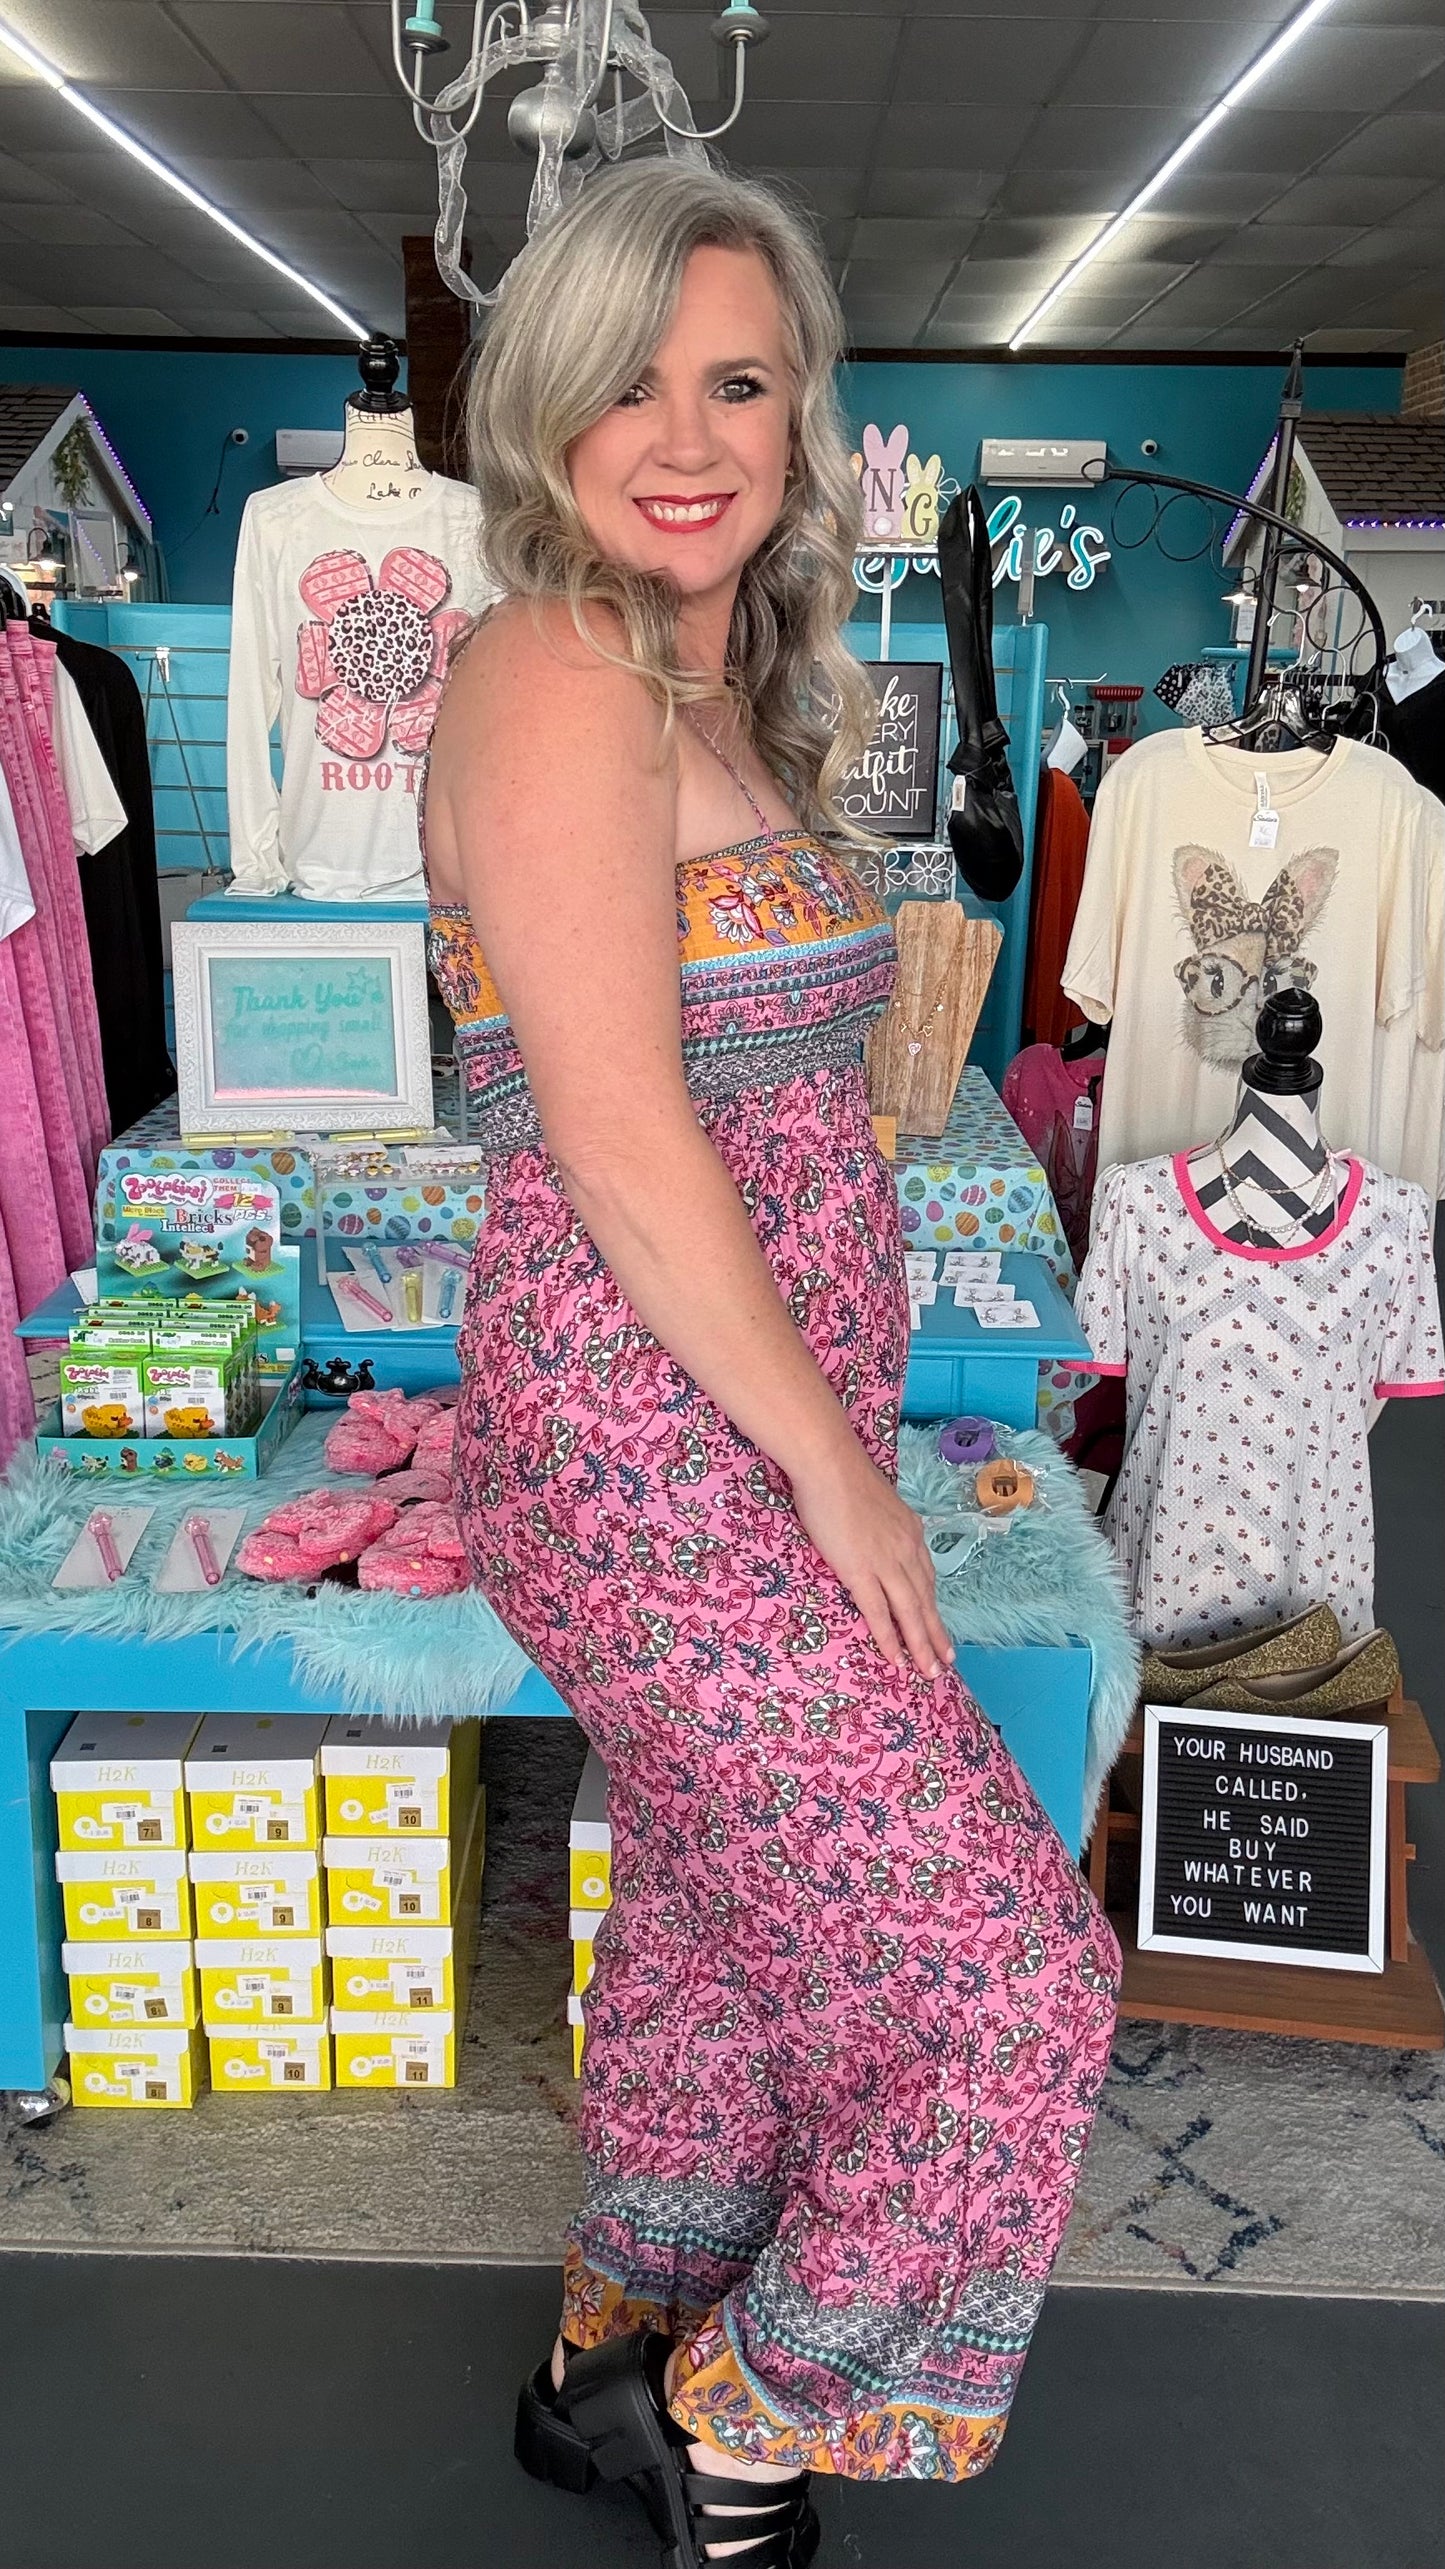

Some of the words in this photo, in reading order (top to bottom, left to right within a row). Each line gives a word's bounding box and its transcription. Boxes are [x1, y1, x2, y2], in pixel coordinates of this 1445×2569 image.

[869, 468, 897, 512] N
[910, 493, 932, 536] G
[841, 745, 919, 795] utfit
[232, 985, 307, 1019] Thank
[233, 1192, 256, 1207] 12
[176, 1208, 233, 1225] Bricks
[161, 1218, 215, 1233] Intellect
[1174, 1736, 1226, 1761] YOUR
[1239, 1743, 1334, 1770] HUSBAND
[366, 1755, 404, 1769] H2K
[98, 1766, 137, 1781] H2K
[232, 1770, 270, 1785] H2K
[404, 1815, 417, 1825] 10
[1203, 1809, 1231, 1831] HE
[1260, 1815, 1309, 1838] SAID
[275, 1828, 282, 1839] 9
[368, 1846, 406, 1862] H2K
[1229, 1838, 1277, 1861] BUY
[102, 1860, 141, 1875] H2K
[235, 1861, 273, 1875] H2K
[1184, 1860, 1312, 1893] WHATEVER
[403, 1902, 416, 1911] 10
[1170, 1894, 1212, 1918] YOU
[1243, 1901, 1308, 1927] WANT
[279, 1914, 286, 1924] 9
[371, 1938, 410, 1953] H2K
[107, 1952, 146, 1968] H2K
[241, 1947, 279, 1961] H2K
[277, 2003, 284, 2013] 9
[416, 1996, 428, 2005] 11
[107, 2032, 146, 2047] H2K
[288, 2069, 300, 2079] 10
[412, 2071, 423, 2081] 11
